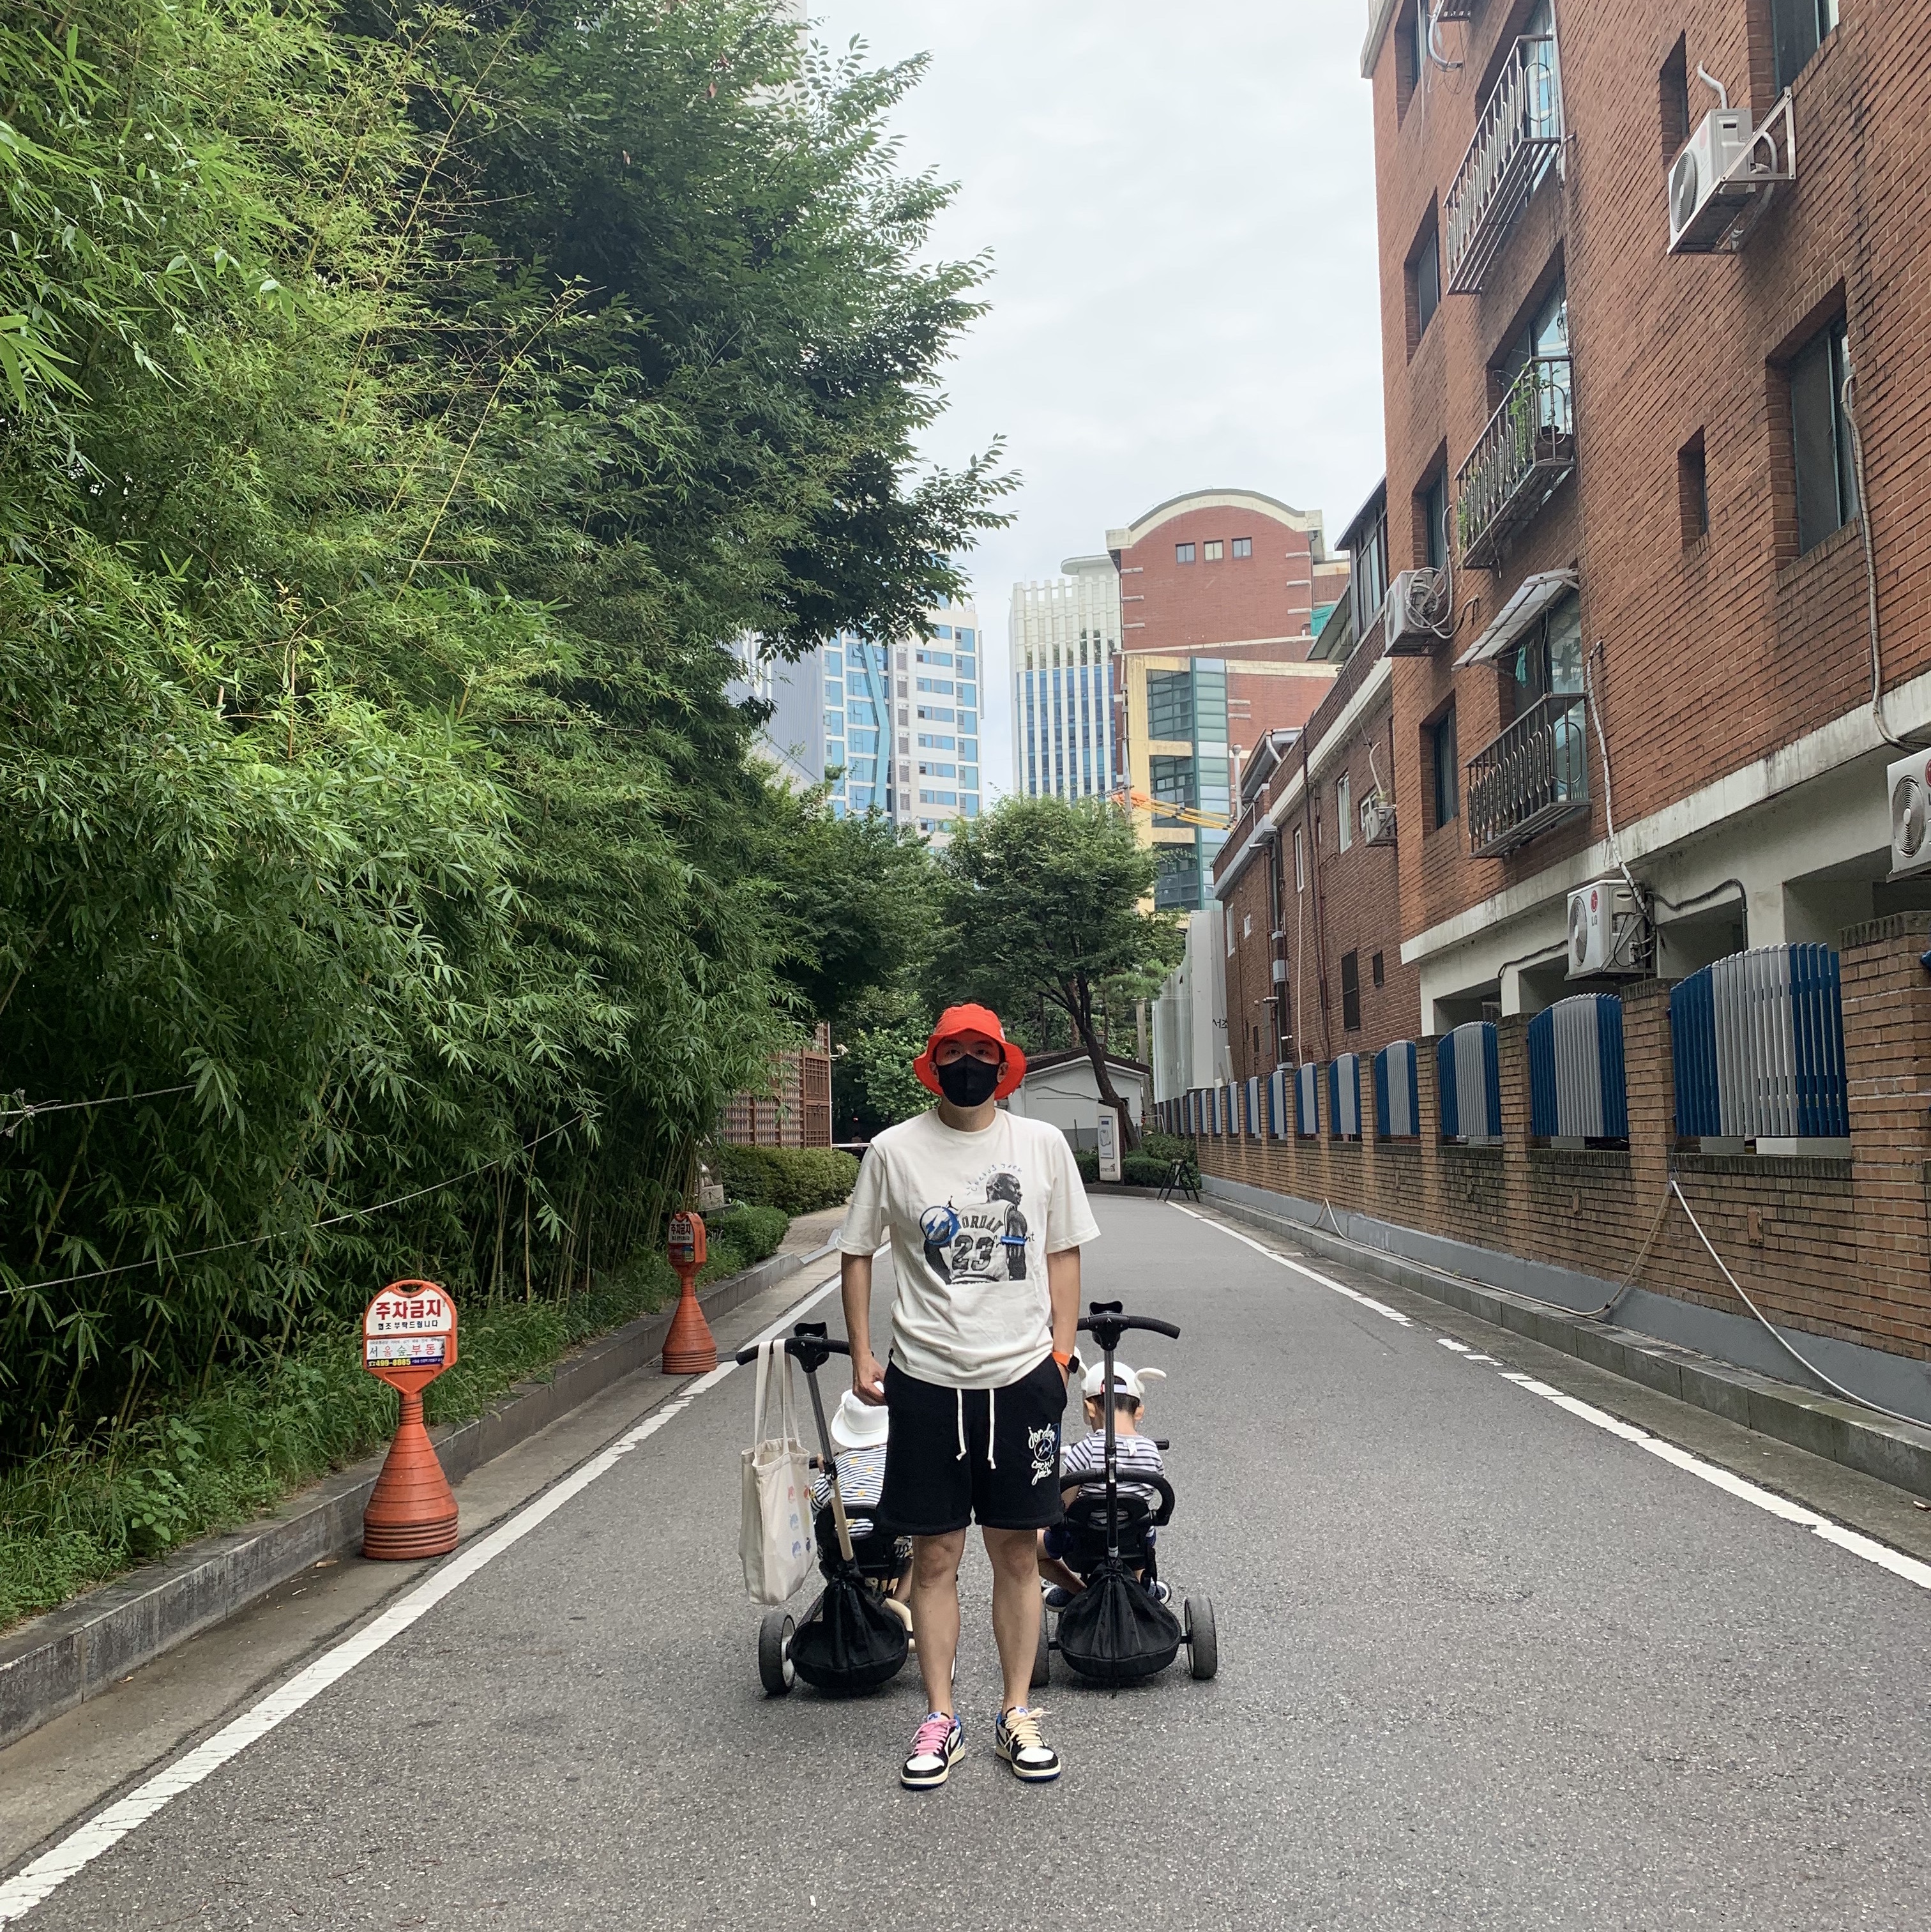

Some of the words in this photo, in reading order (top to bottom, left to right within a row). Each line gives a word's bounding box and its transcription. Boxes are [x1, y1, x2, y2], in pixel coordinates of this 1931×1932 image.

[1591, 915, 1598, 927] LG
[961, 1215, 1004, 1233] ORDAN
[951, 1235, 995, 1272] 23
[376, 1299, 441, 1321] 주차금지
